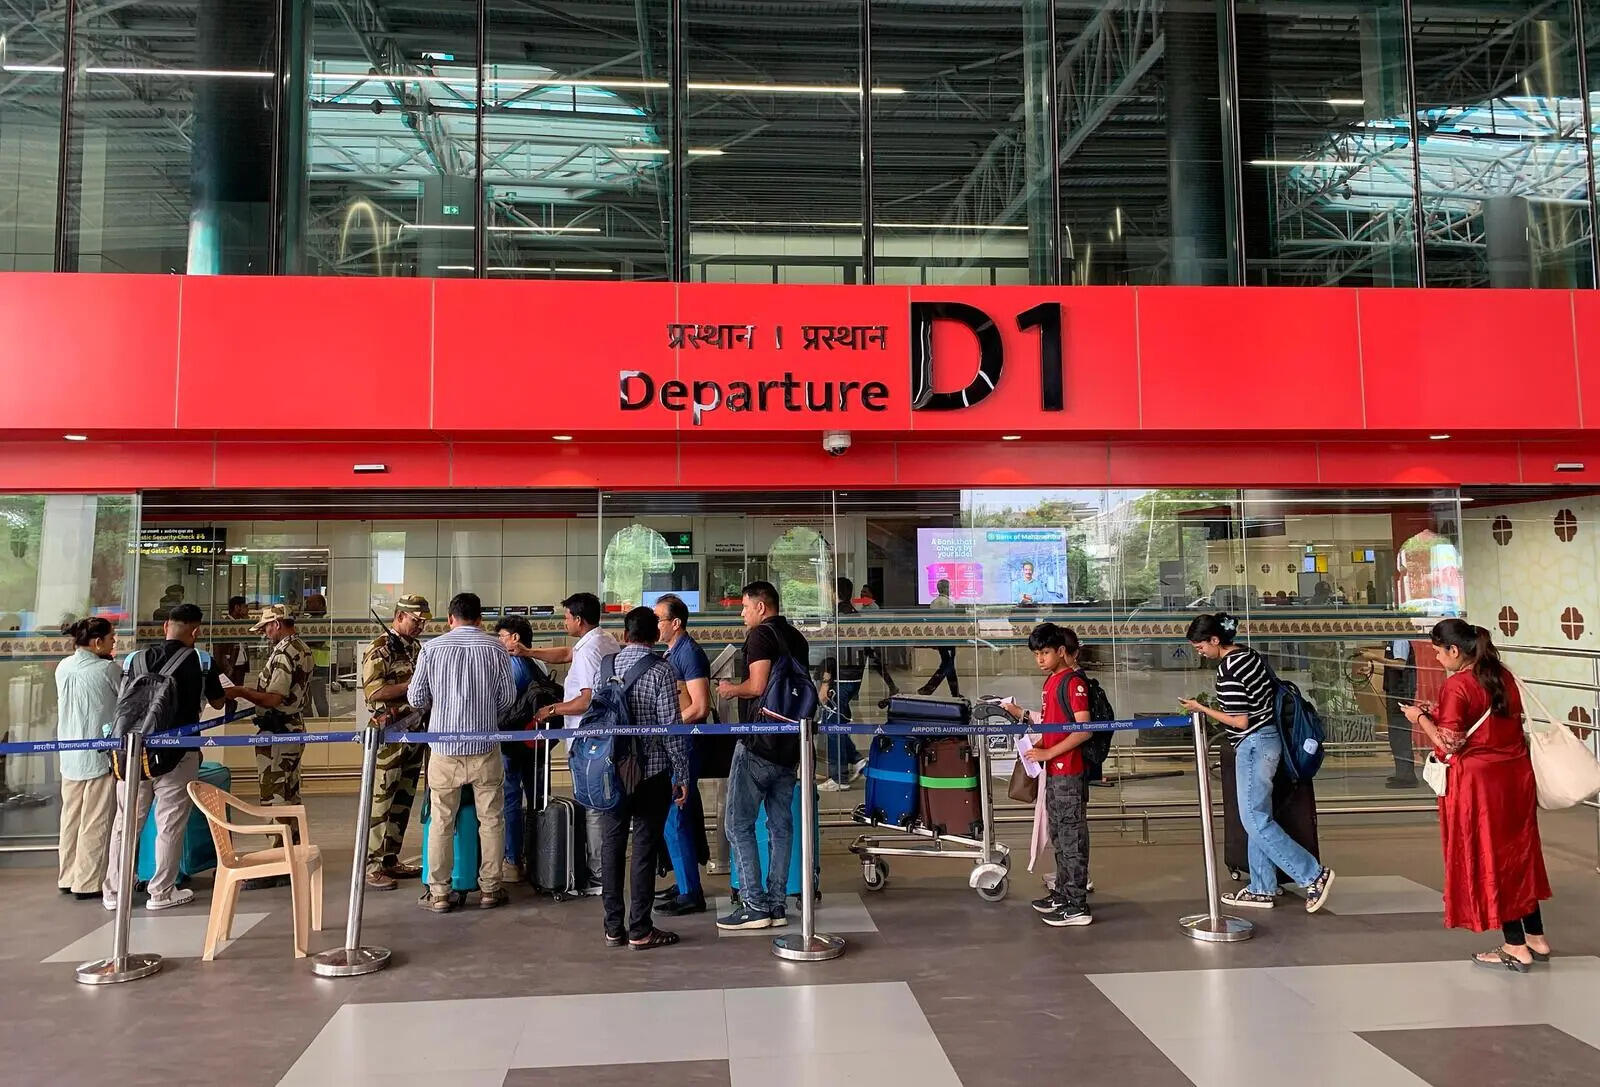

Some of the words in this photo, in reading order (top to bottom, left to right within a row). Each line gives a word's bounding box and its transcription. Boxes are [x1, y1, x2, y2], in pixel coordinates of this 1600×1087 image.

[667, 323, 755, 350] प्रस्थान
[801, 325, 888, 350] प्रस्थान
[911, 302, 1064, 412] D1
[619, 370, 889, 426] Departure
[169, 545, 180, 554] 5A
[182, 545, 189, 554] &
[190, 545, 202, 554] 5B
[572, 729, 604, 737] AIRPORTS
